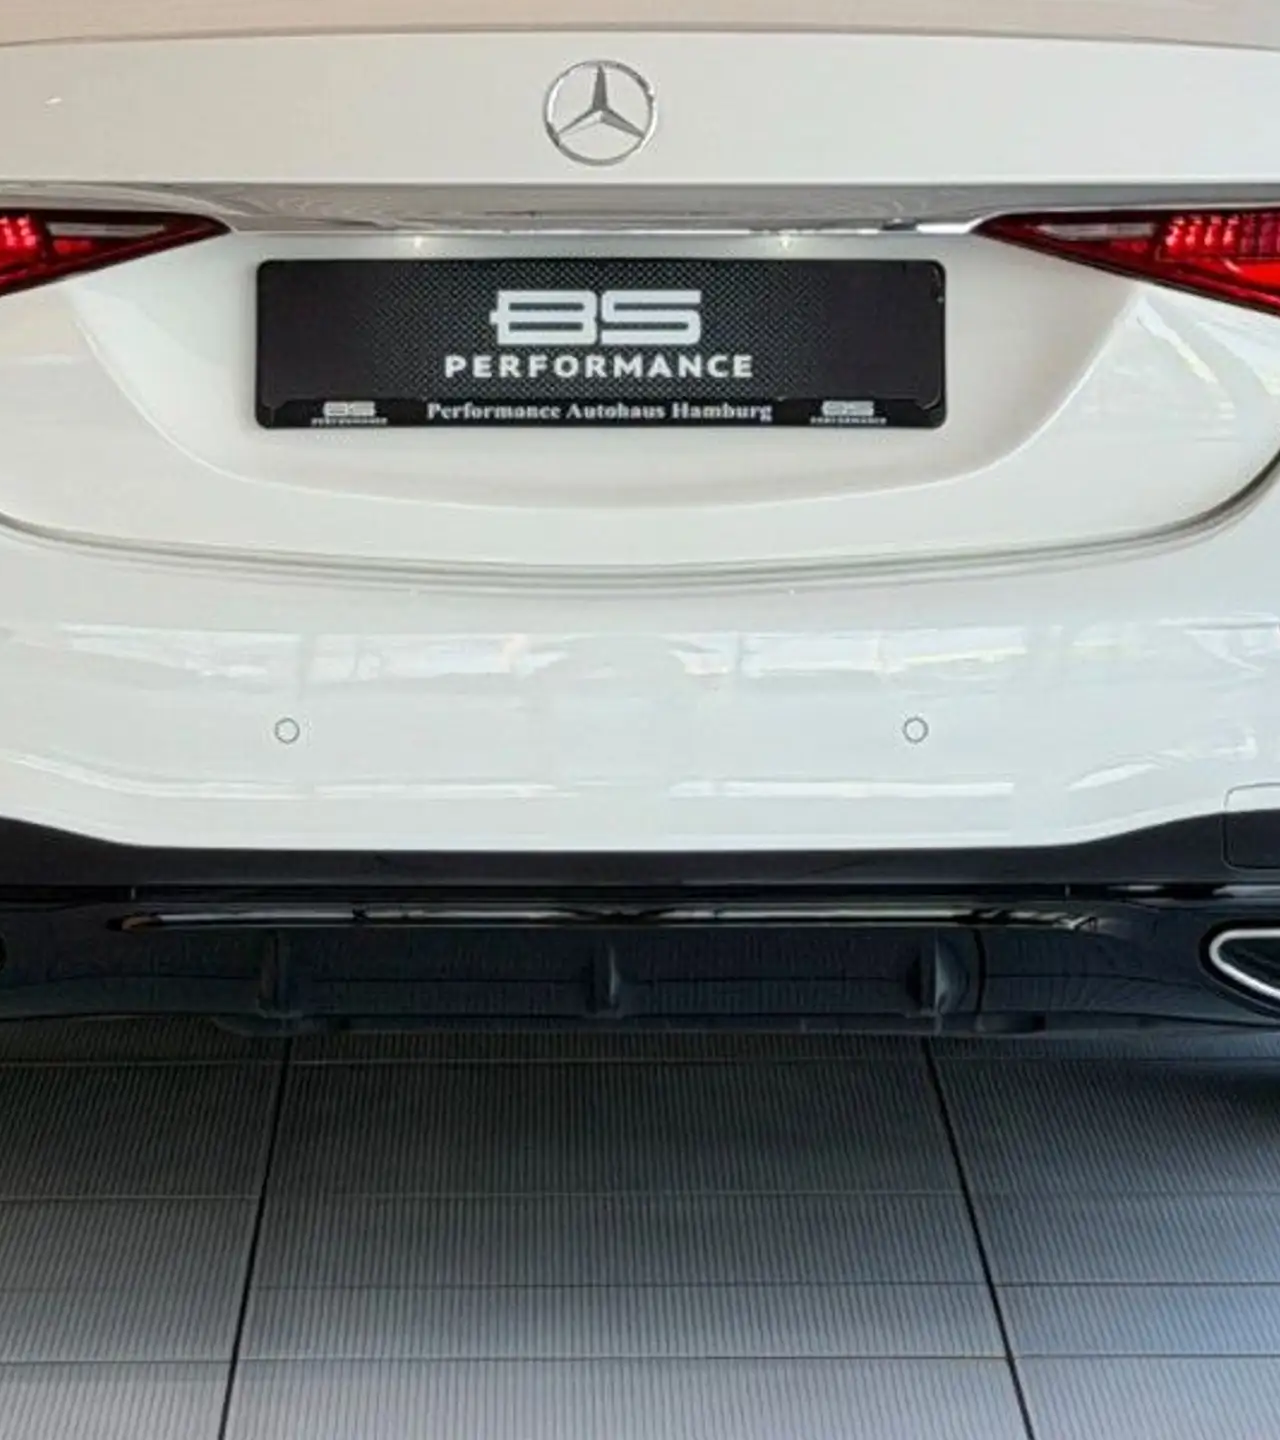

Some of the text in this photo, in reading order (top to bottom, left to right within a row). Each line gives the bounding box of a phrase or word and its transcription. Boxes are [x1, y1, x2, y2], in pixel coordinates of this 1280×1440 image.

[489, 290, 701, 346] BS
[444, 354, 753, 379] PERFORMANCE
[426, 402, 773, 422] Performance Autohaus Hamburg
